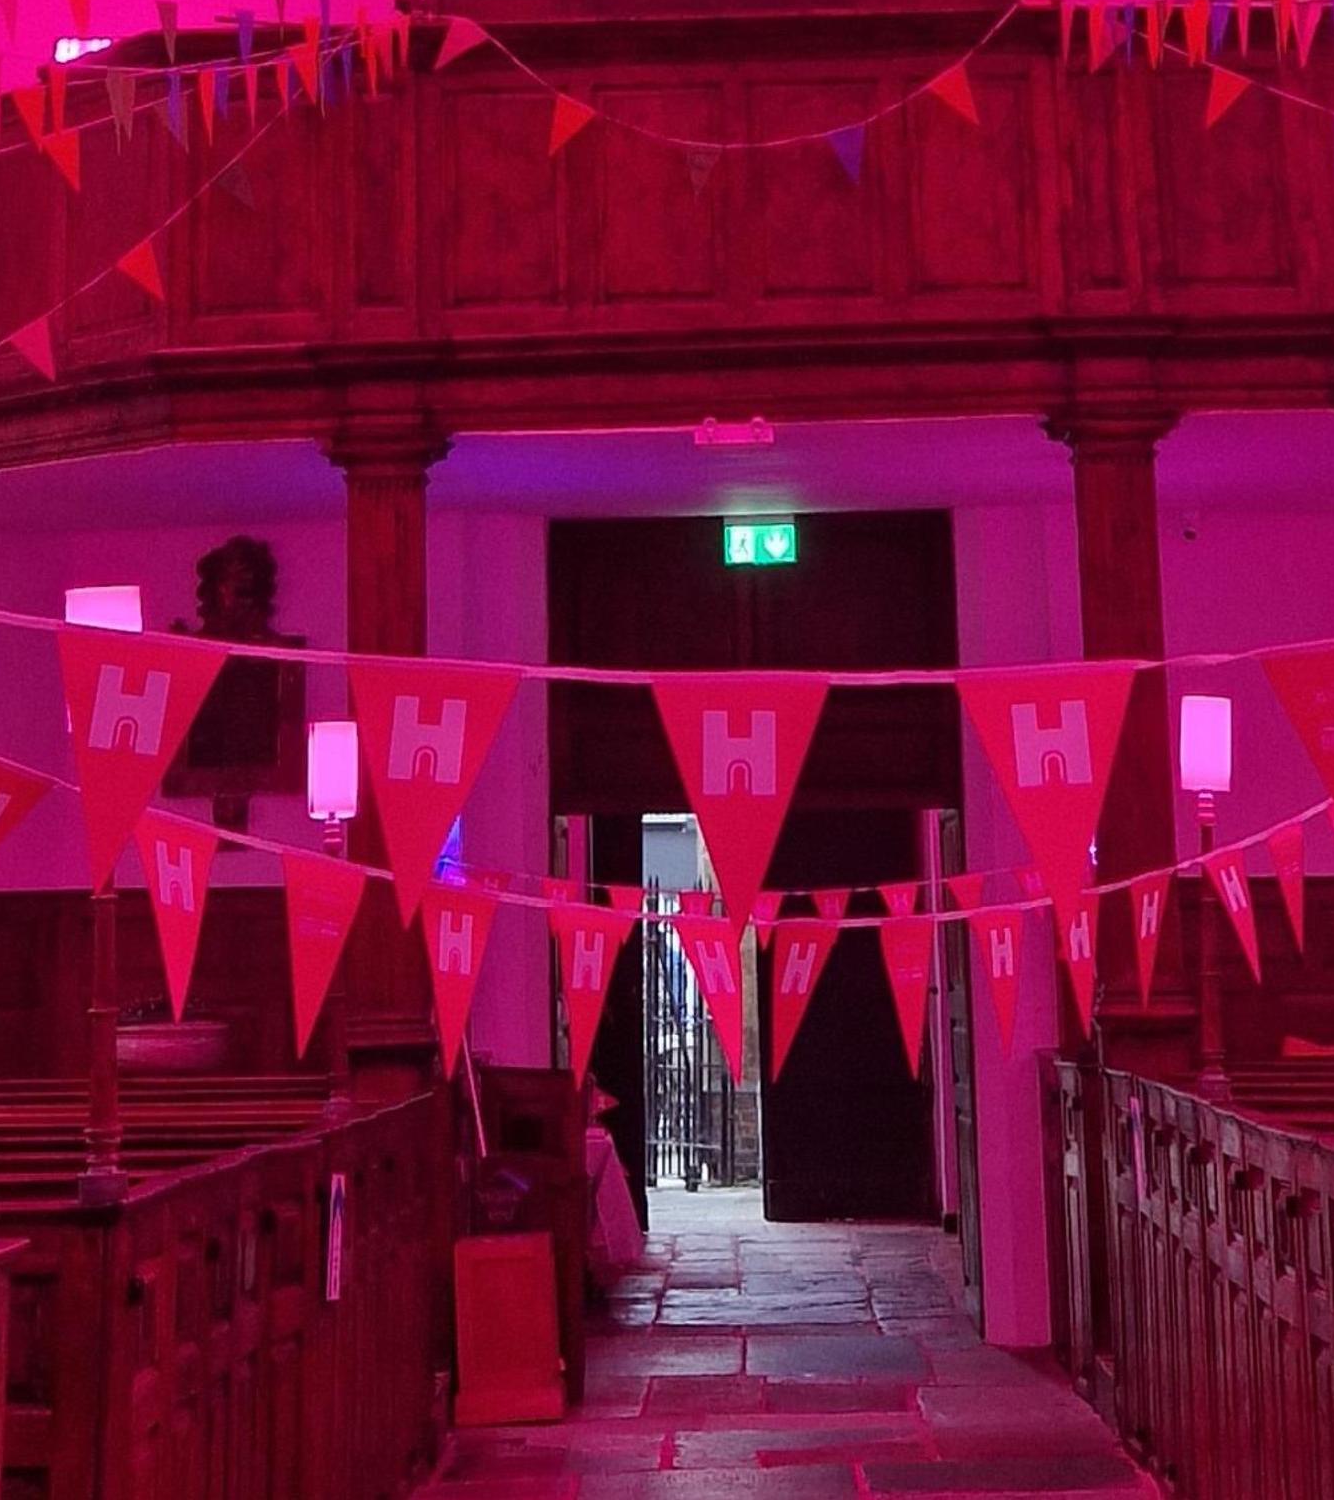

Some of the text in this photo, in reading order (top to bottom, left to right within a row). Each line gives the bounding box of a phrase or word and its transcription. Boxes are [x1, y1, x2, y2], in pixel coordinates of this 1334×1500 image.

[88, 664, 170, 755] H
[388, 695, 467, 783] H
[703, 710, 776, 795] H
[1012, 700, 1092, 787] H
[155, 840, 193, 911] H
[1218, 865, 1247, 911] H
[439, 911, 472, 974] H
[1071, 912, 1090, 960] H
[1140, 890, 1159, 939] H
[572, 930, 603, 989] H
[696, 941, 736, 993] H
[782, 942, 817, 994] H
[990, 928, 1013, 977] H
